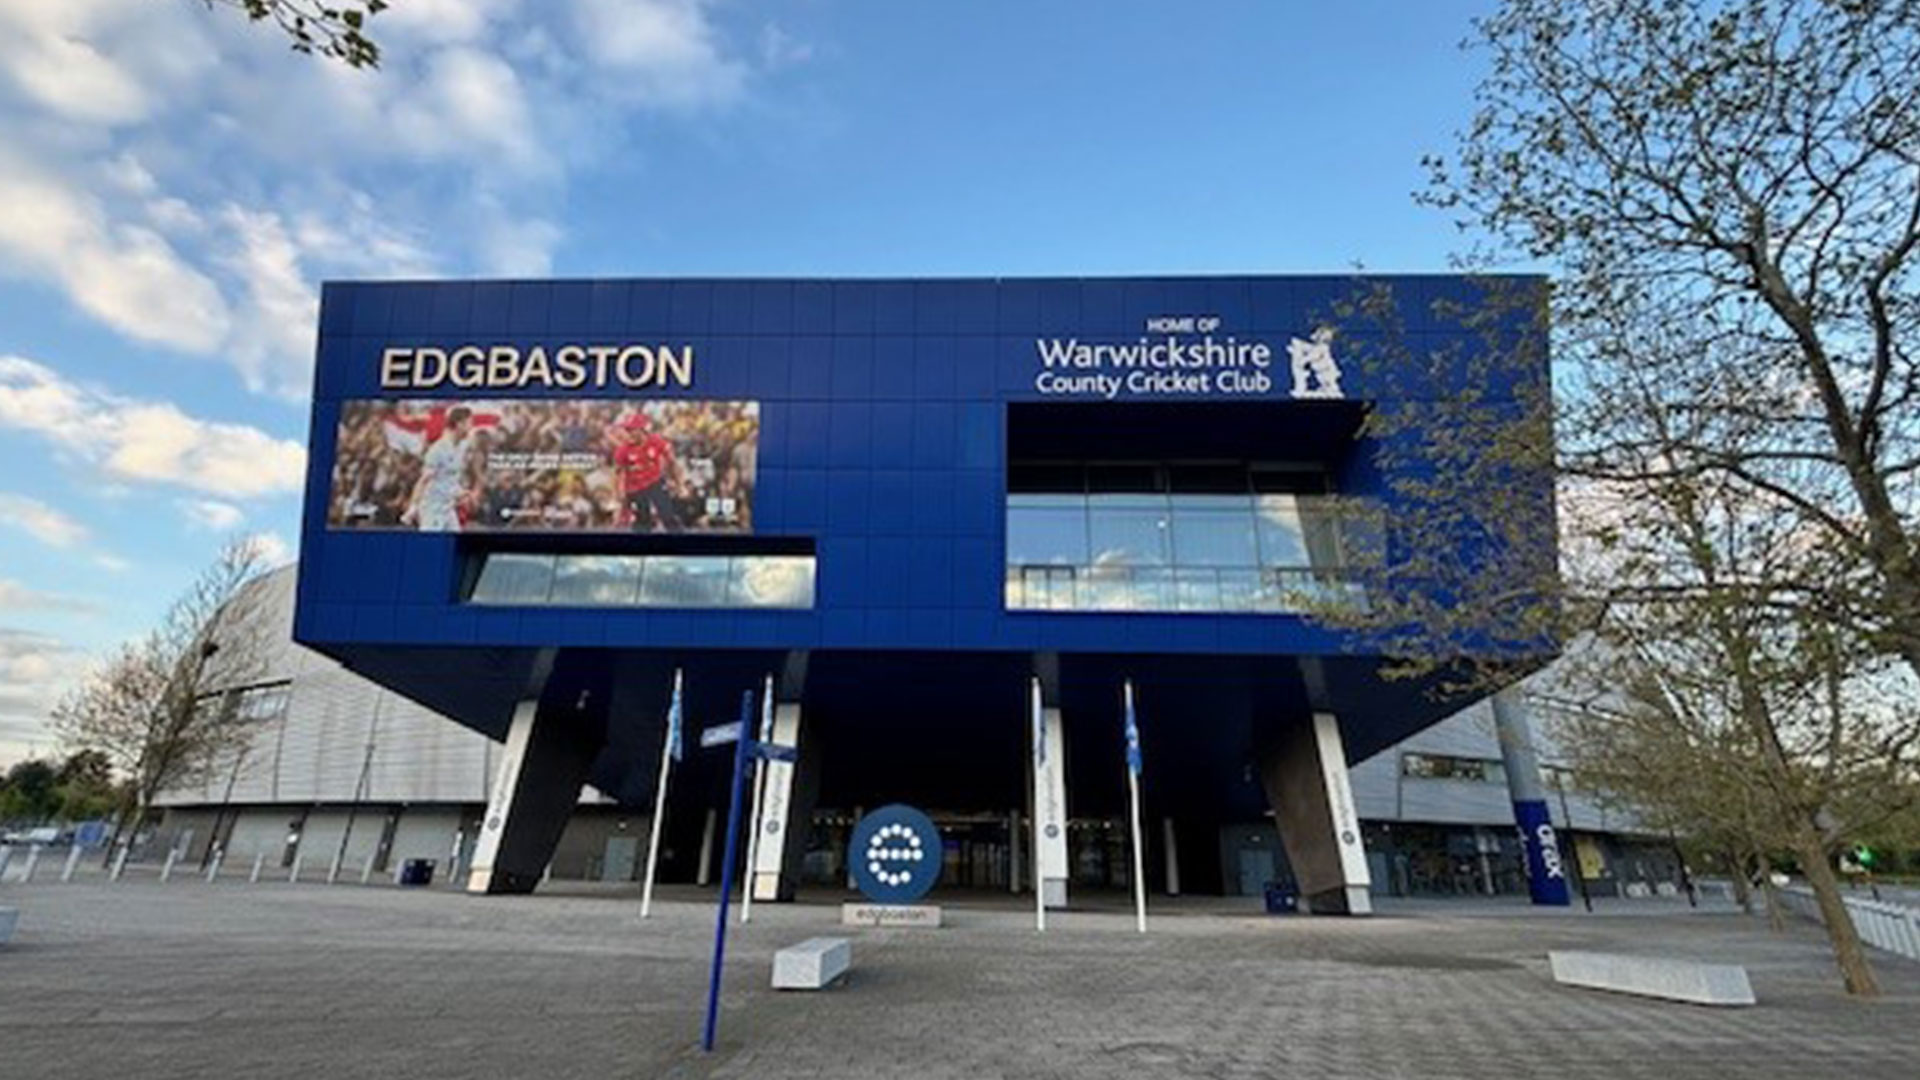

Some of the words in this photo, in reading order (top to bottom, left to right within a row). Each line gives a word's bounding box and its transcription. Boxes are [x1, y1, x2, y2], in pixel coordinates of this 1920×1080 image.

[1147, 318, 1195, 332] HOME
[1197, 318, 1220, 332] OF
[381, 346, 693, 387] EDGBASTON
[1037, 336, 1271, 368] Warwickshire
[1036, 371, 1122, 399] County
[1127, 370, 1211, 393] Cricket
[1216, 370, 1271, 393] Club
